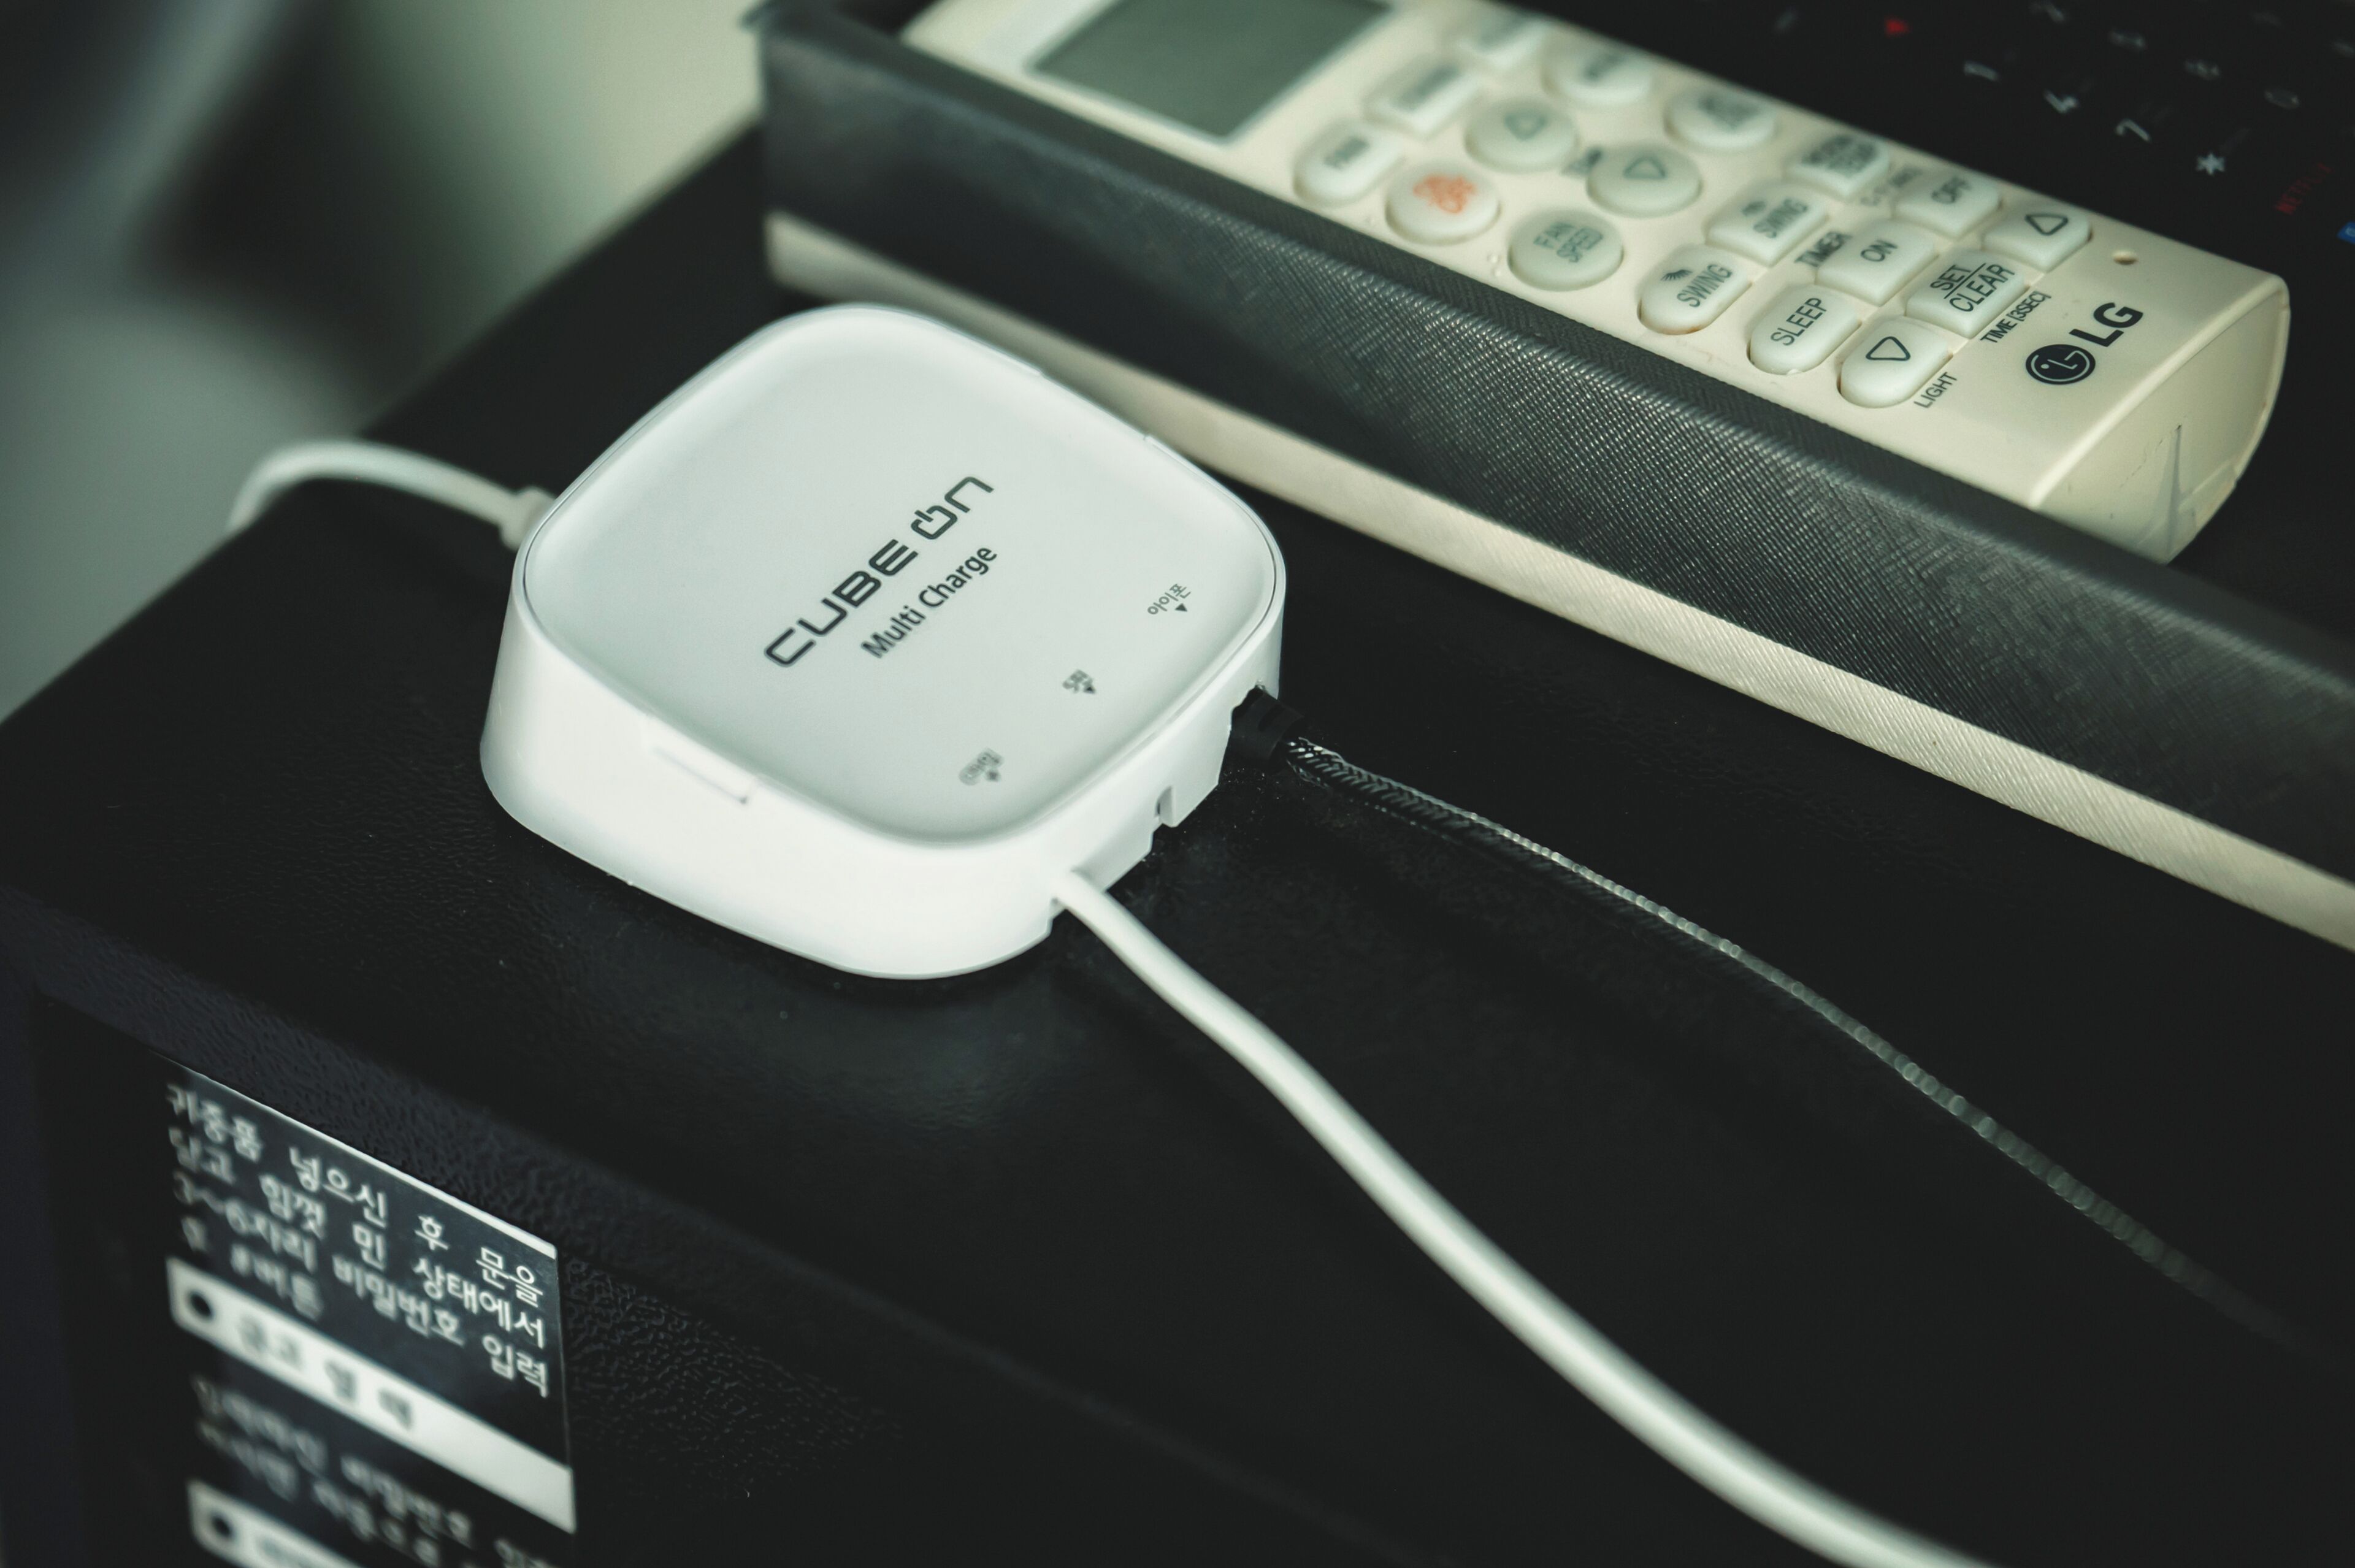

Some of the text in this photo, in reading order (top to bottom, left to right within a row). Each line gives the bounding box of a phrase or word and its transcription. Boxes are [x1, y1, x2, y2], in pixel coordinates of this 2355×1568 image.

[2115, 118, 2150, 142] 7
[1794, 231, 1853, 267] TIMER
[1860, 239, 1897, 262] ON
[1677, 264, 1733, 308] SWING
[1930, 264, 1973, 291] SET
[1949, 264, 2015, 312] CLEAR
[1771, 297, 1828, 346] SLEEP
[1980, 318, 2018, 343] TIME
[2069, 302, 2143, 347] LG
[1913, 372, 1958, 408] LIGHT
[860, 543, 997, 659] Multi Charge
[1147, 583, 1191, 614] 아이폰
[414, 1215, 450, 1251] 후
[475, 1247, 543, 1308] 문을
[351, 1222, 388, 1271] 민
[412, 1258, 544, 1349] 상태에서
[331, 1254, 465, 1347] 비밀번호
[482, 1334, 550, 1398] 입력
